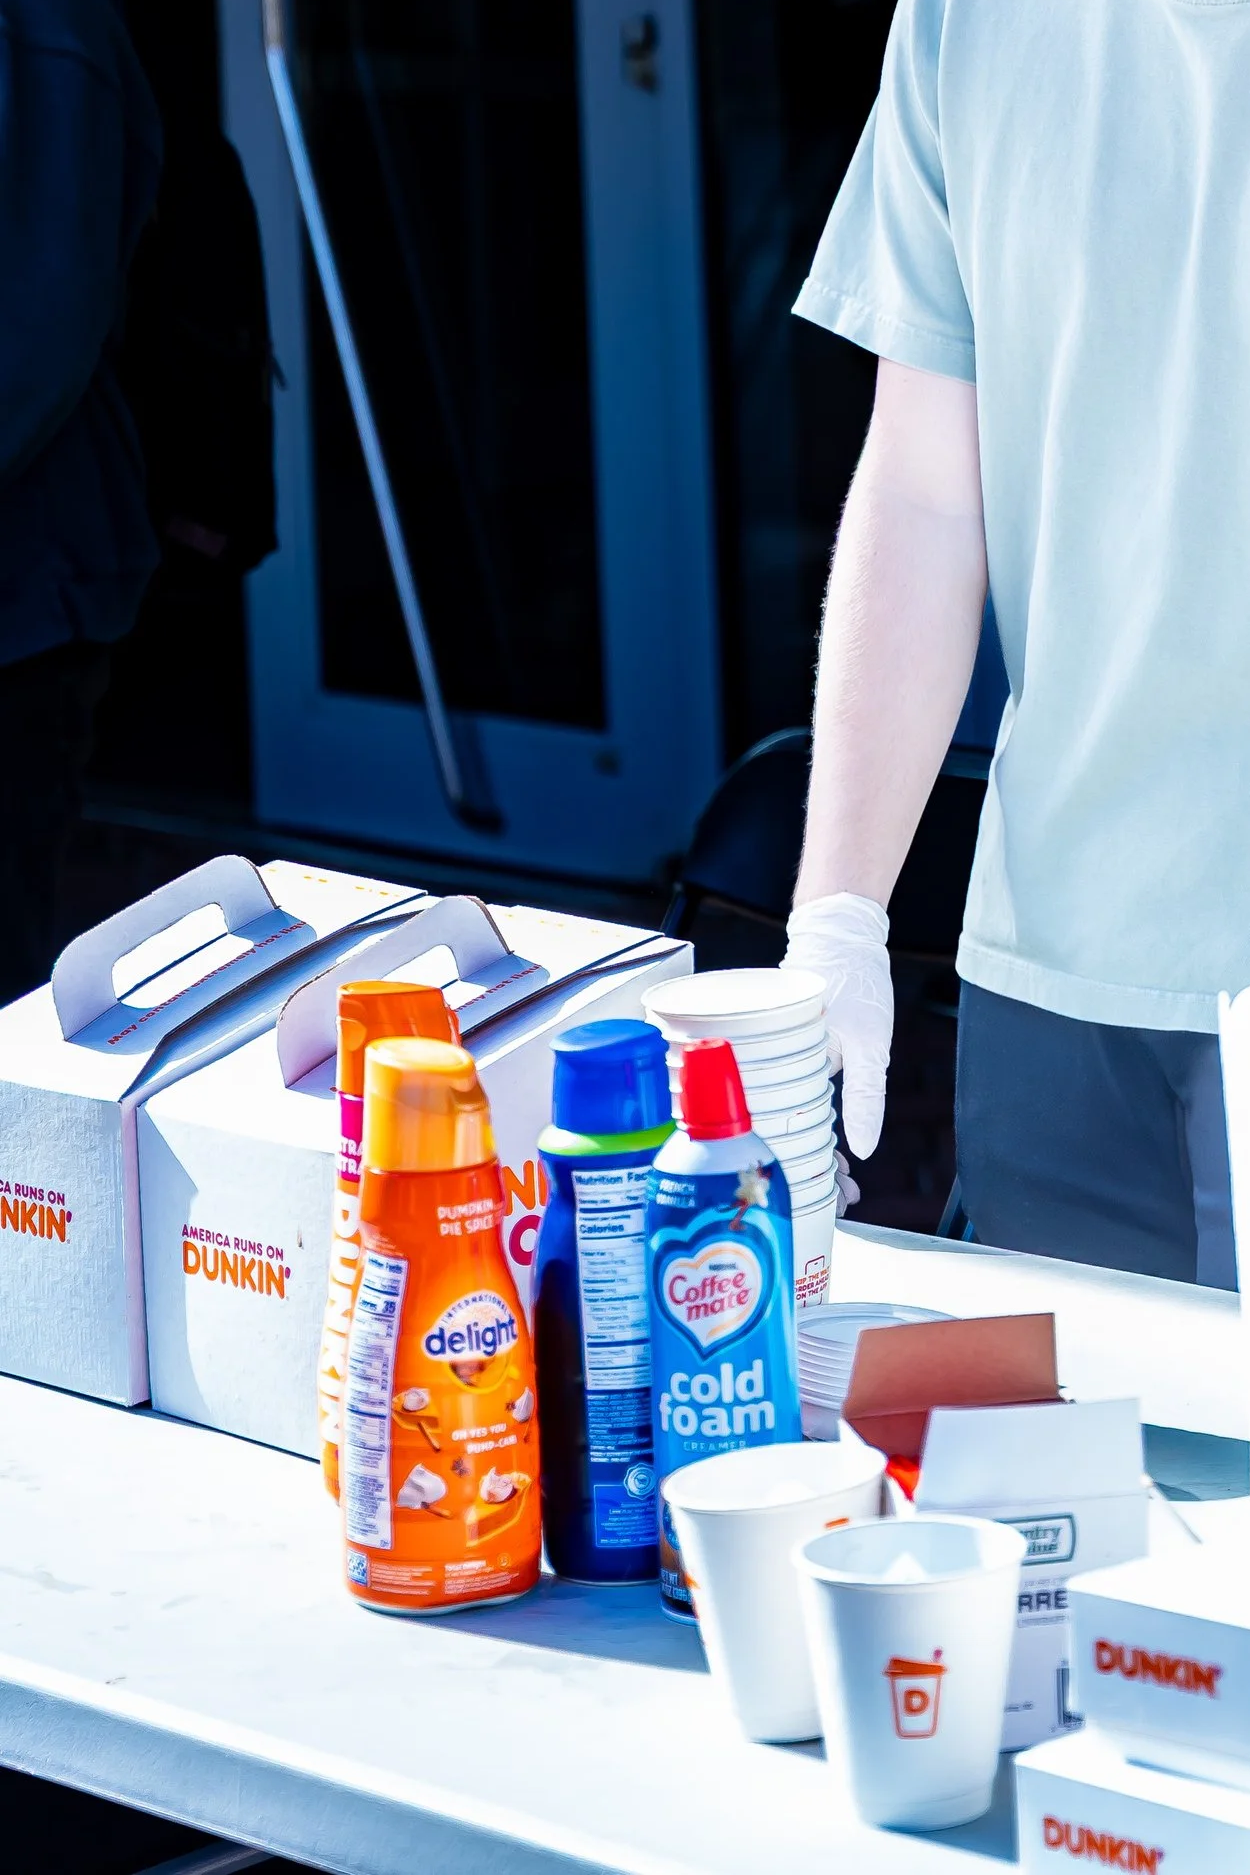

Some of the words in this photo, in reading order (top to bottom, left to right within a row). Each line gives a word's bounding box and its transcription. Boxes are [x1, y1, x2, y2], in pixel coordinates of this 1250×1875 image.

[107, 1023, 138, 1046] May
[138, 988, 191, 1023] contain
[191, 948, 257, 988] extremely
[254, 933, 282, 948] hot
[281, 920, 307, 935] liqu
[485, 979, 514, 994] hot
[15, 1182, 44, 1201] RUNS
[47, 1190, 65, 1206] ON
[437, 1198, 494, 1220] PUMPKIN
[0, 1196, 72, 1243] NKIN'
[439, 1221, 462, 1237] PIE
[464, 1214, 495, 1235] SPICE
[181, 1224, 230, 1248] AMERICA
[234, 1238, 263, 1257] RUNS
[266, 1245, 284, 1261] ON
[182, 1240, 291, 1300] DUNKIN'
[668, 1272, 746, 1306] Coffee
[686, 1287, 752, 1322] mate
[425, 1316, 519, 1357] delight
[670, 1359, 765, 1404] cold
[659, 1392, 775, 1437] foam
[683, 1440, 747, 1453] CREAMER
[1017, 1589, 1069, 1614] RRE
[1094, 1638, 1222, 1698] DUNKIN'
[904, 1689, 930, 1717] D
